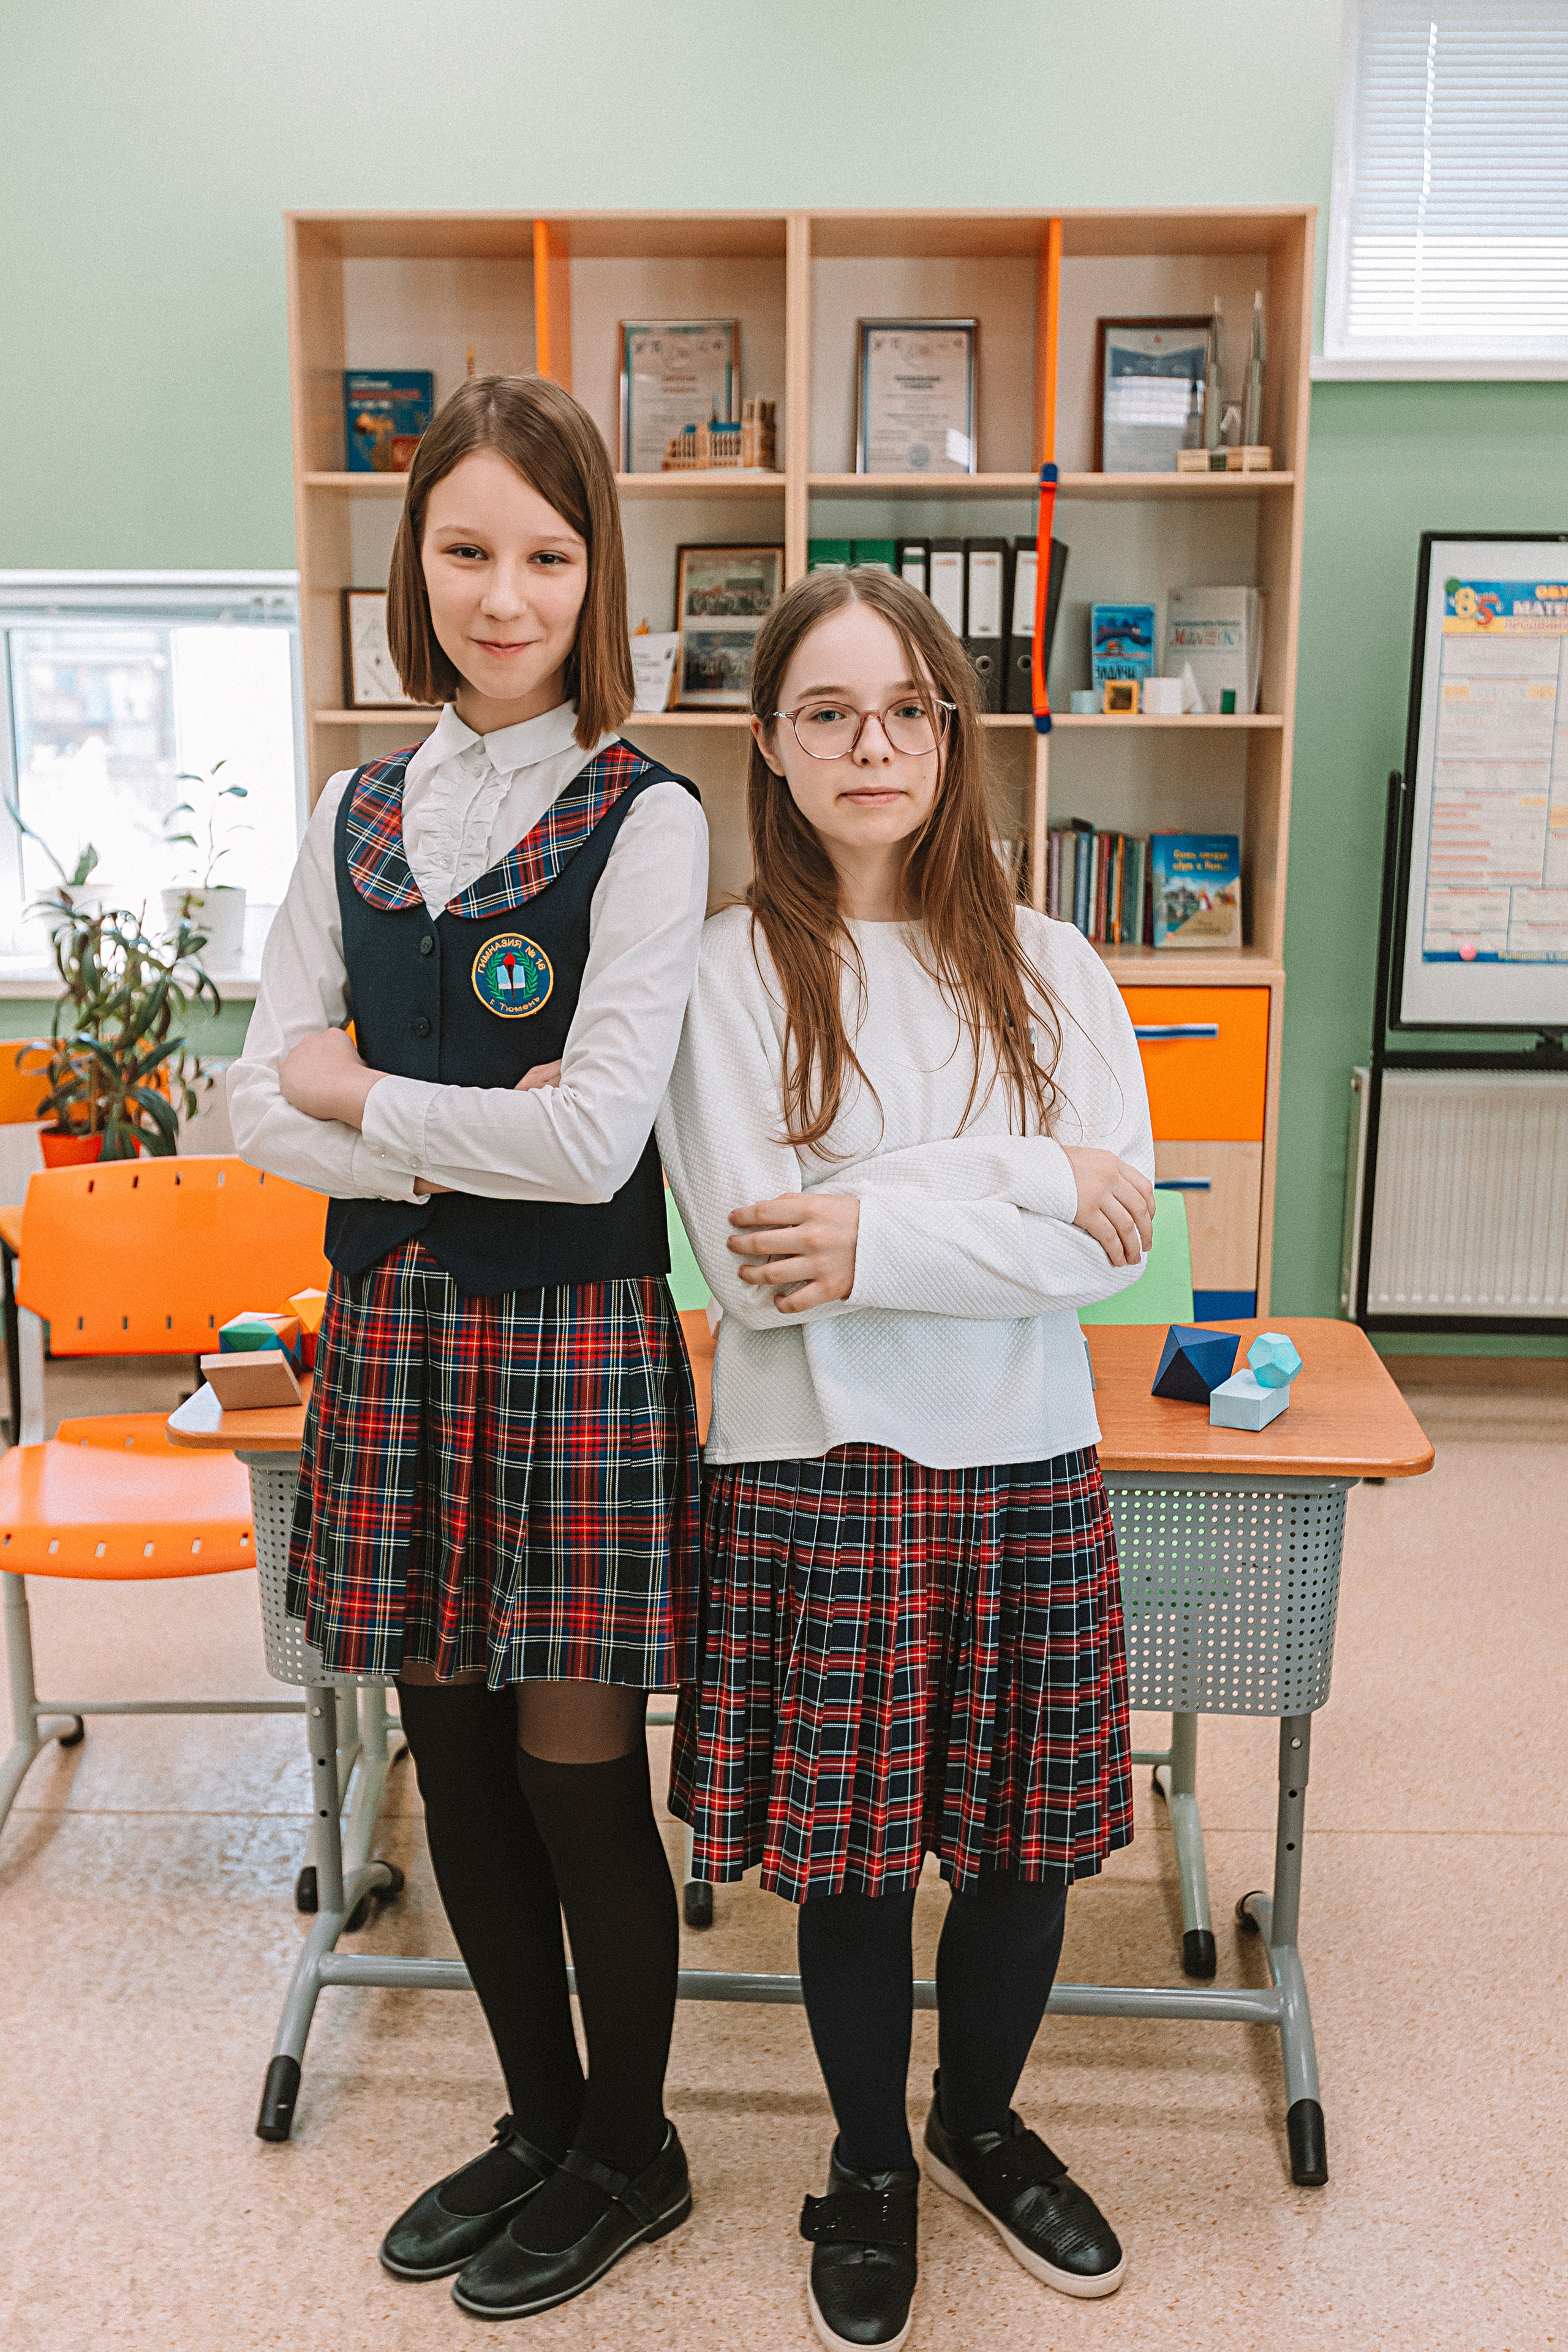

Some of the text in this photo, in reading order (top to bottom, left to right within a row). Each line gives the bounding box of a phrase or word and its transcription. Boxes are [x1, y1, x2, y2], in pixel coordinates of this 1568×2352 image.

[1512, 600, 1568, 616] МАТЕ
[477, 938, 546, 973] ГИМНАЗИЯ № 16
[499, 997, 540, 1012] Тюмень
